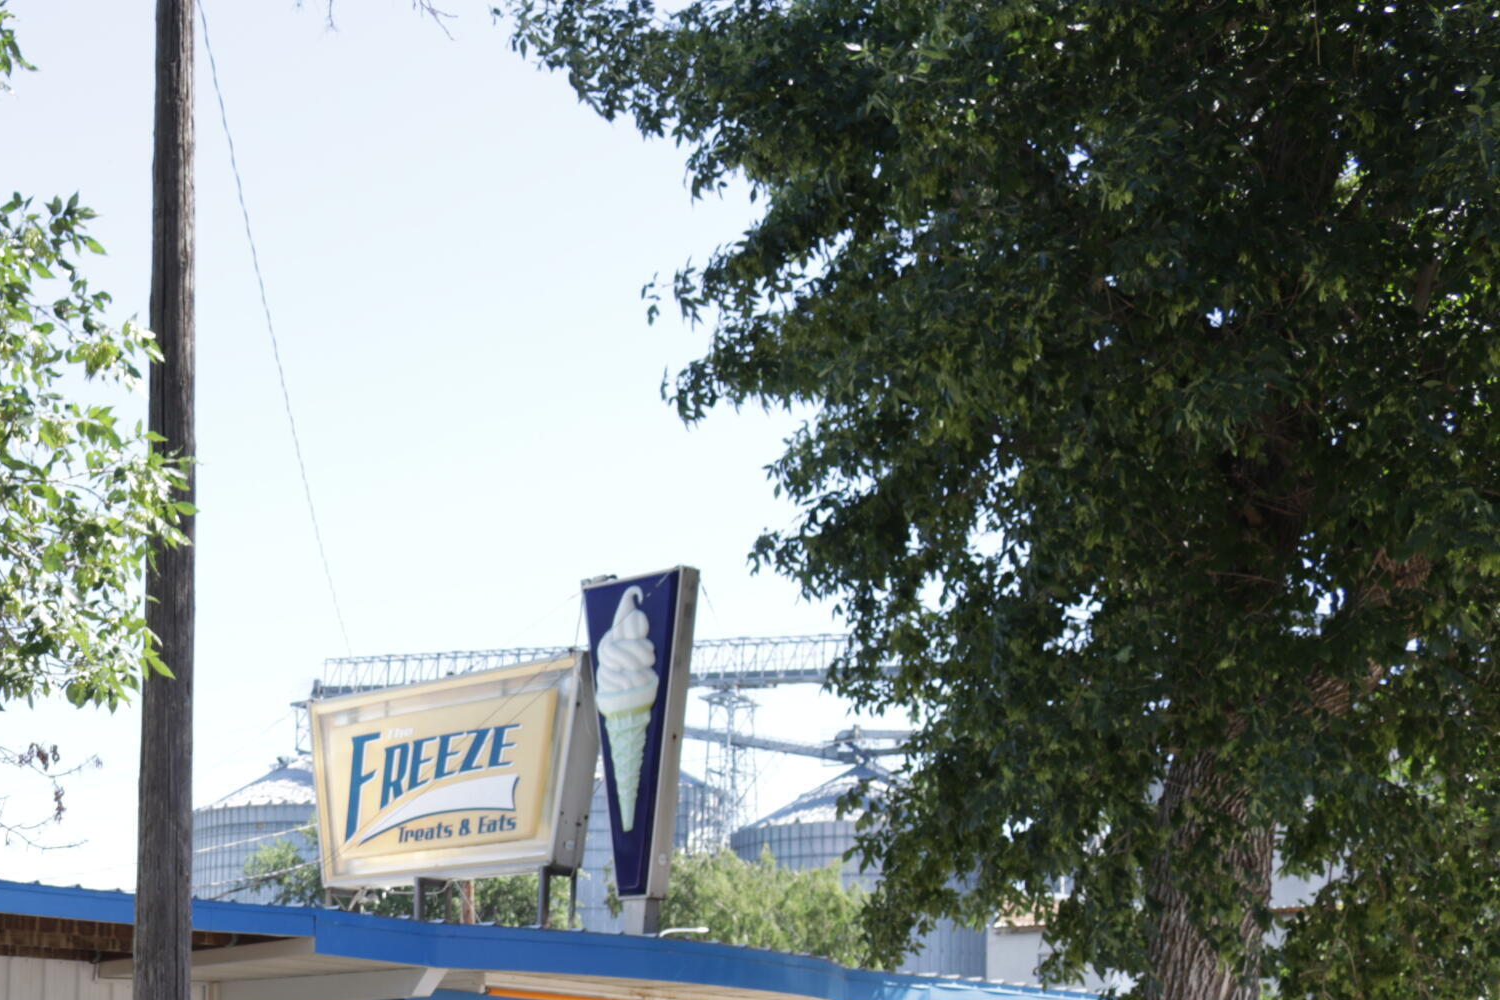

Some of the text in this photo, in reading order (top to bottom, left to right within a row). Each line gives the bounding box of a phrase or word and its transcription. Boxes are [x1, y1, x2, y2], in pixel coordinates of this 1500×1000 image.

[345, 724, 521, 843] FREEZE
[398, 814, 517, 843] Treats & Eats
